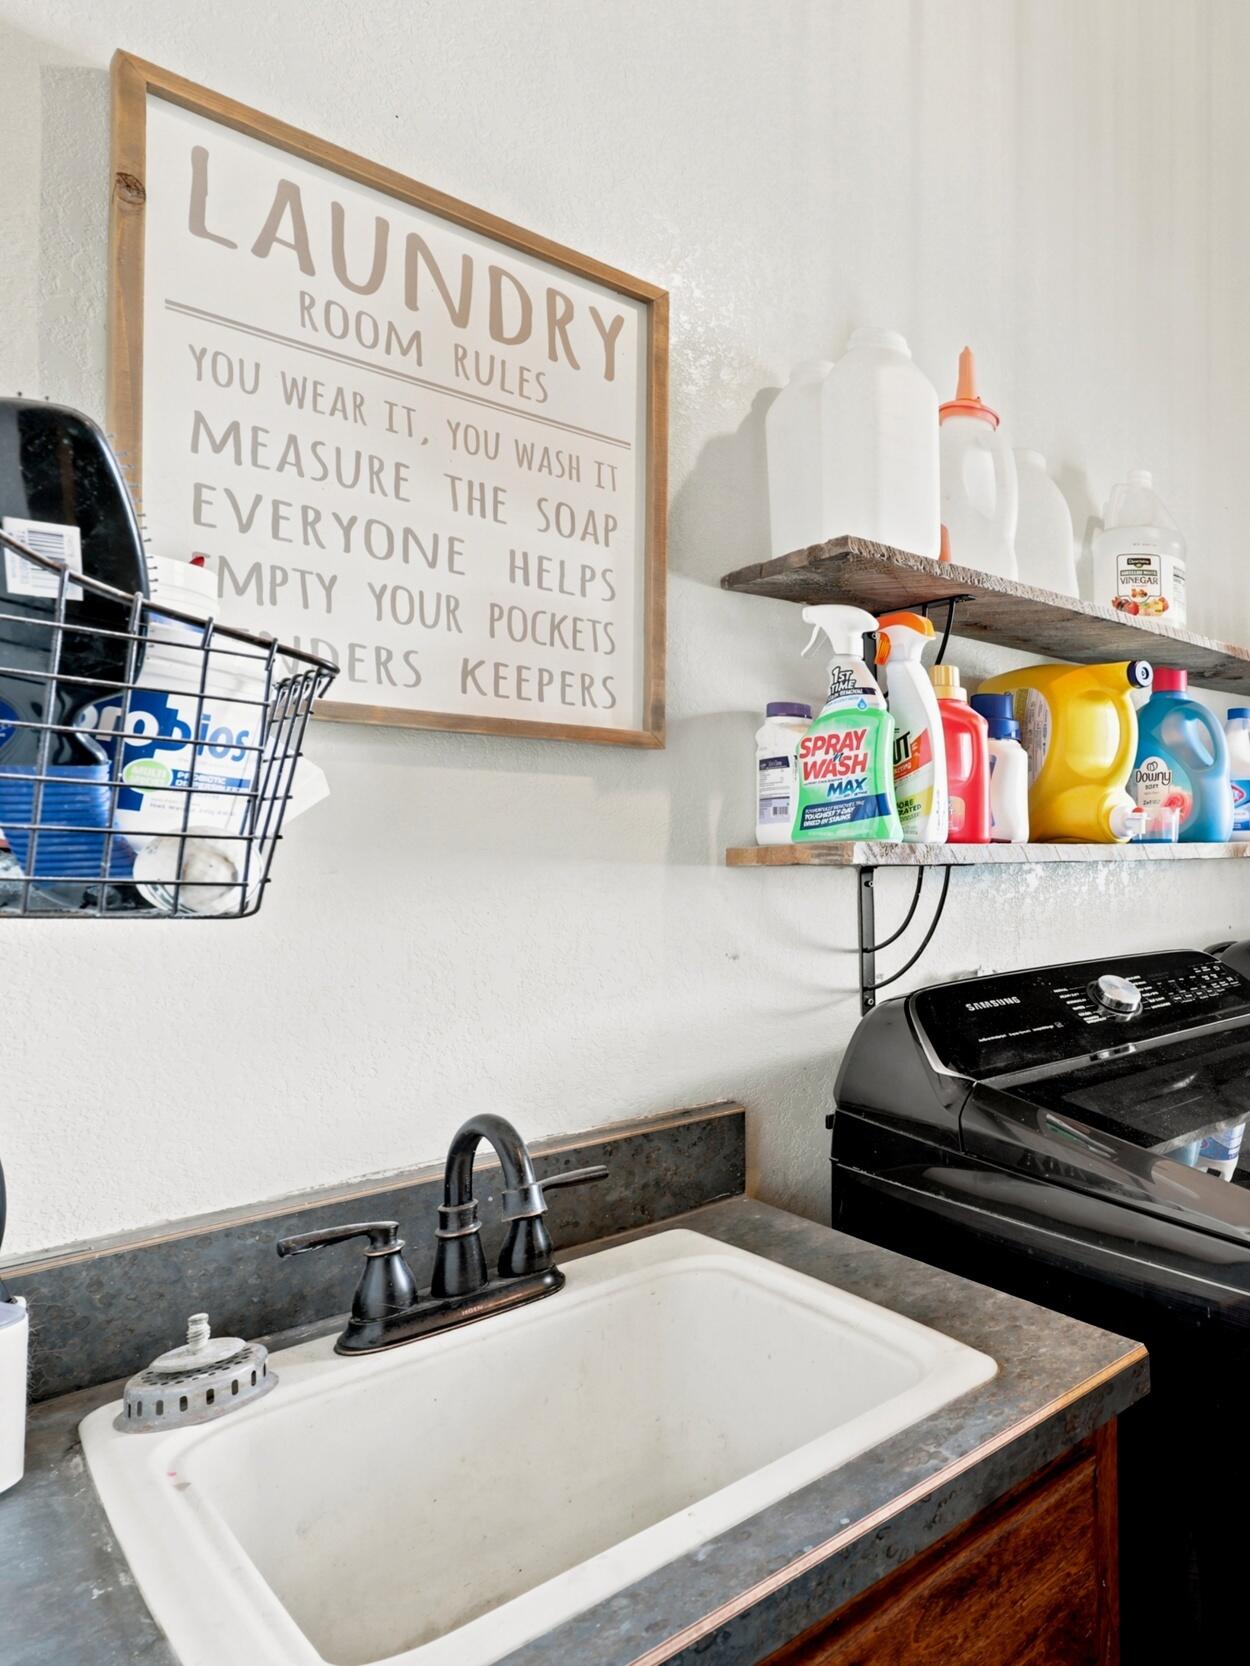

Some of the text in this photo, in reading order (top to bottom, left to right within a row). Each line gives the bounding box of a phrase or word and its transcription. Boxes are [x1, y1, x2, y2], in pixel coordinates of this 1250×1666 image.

[189, 145, 625, 381] LAUNDRY
[299, 290, 549, 404] ROOM RULES
[188, 344, 619, 493] YOU WEAR IT, YOU WASH IT
[190, 410, 619, 548] MEASURE THE SOAP
[192, 482, 617, 602] EVERYONE HELPS
[1119, 576, 1159, 585] VINEGAR
[192, 551, 617, 656] MPTY YOUR POCKETS
[460, 656, 618, 710] KEEPERS
[830, 680, 857, 696] TIME
[831, 666, 854, 684] 1ST
[799, 728, 868, 760] SPRAY
[802, 752, 868, 782] WASH
[1135, 770, 1171, 786] Downy
[826, 776, 868, 798] MAX
[965, 996, 1021, 1012] SAMSUNG
